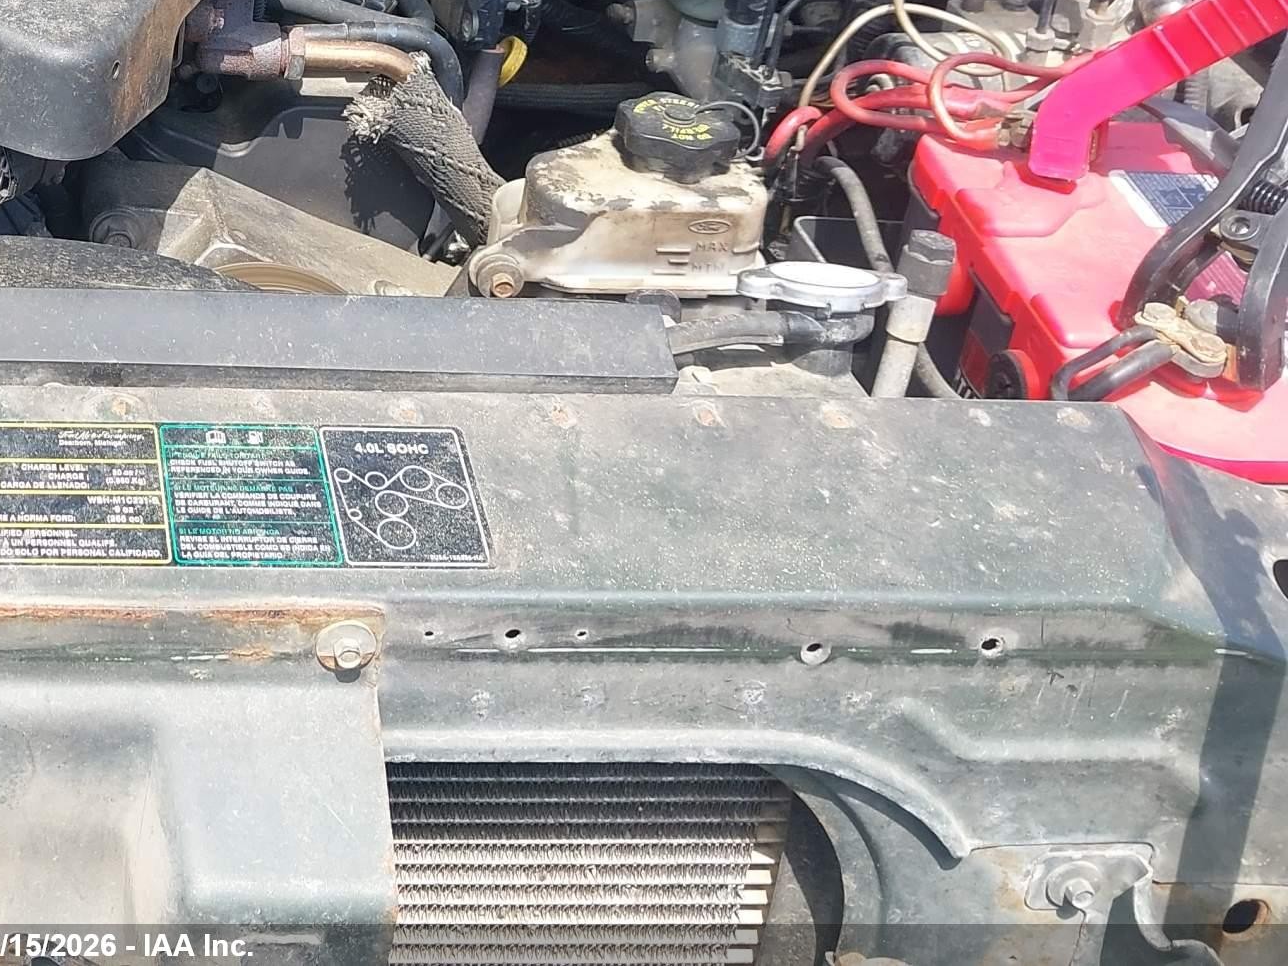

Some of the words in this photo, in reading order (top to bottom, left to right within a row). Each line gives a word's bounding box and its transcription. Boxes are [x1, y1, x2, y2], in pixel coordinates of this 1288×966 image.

[695, 241, 729, 252] MAX
[354, 443, 385, 454] 4.0L
[386, 443, 429, 454] SOHC
